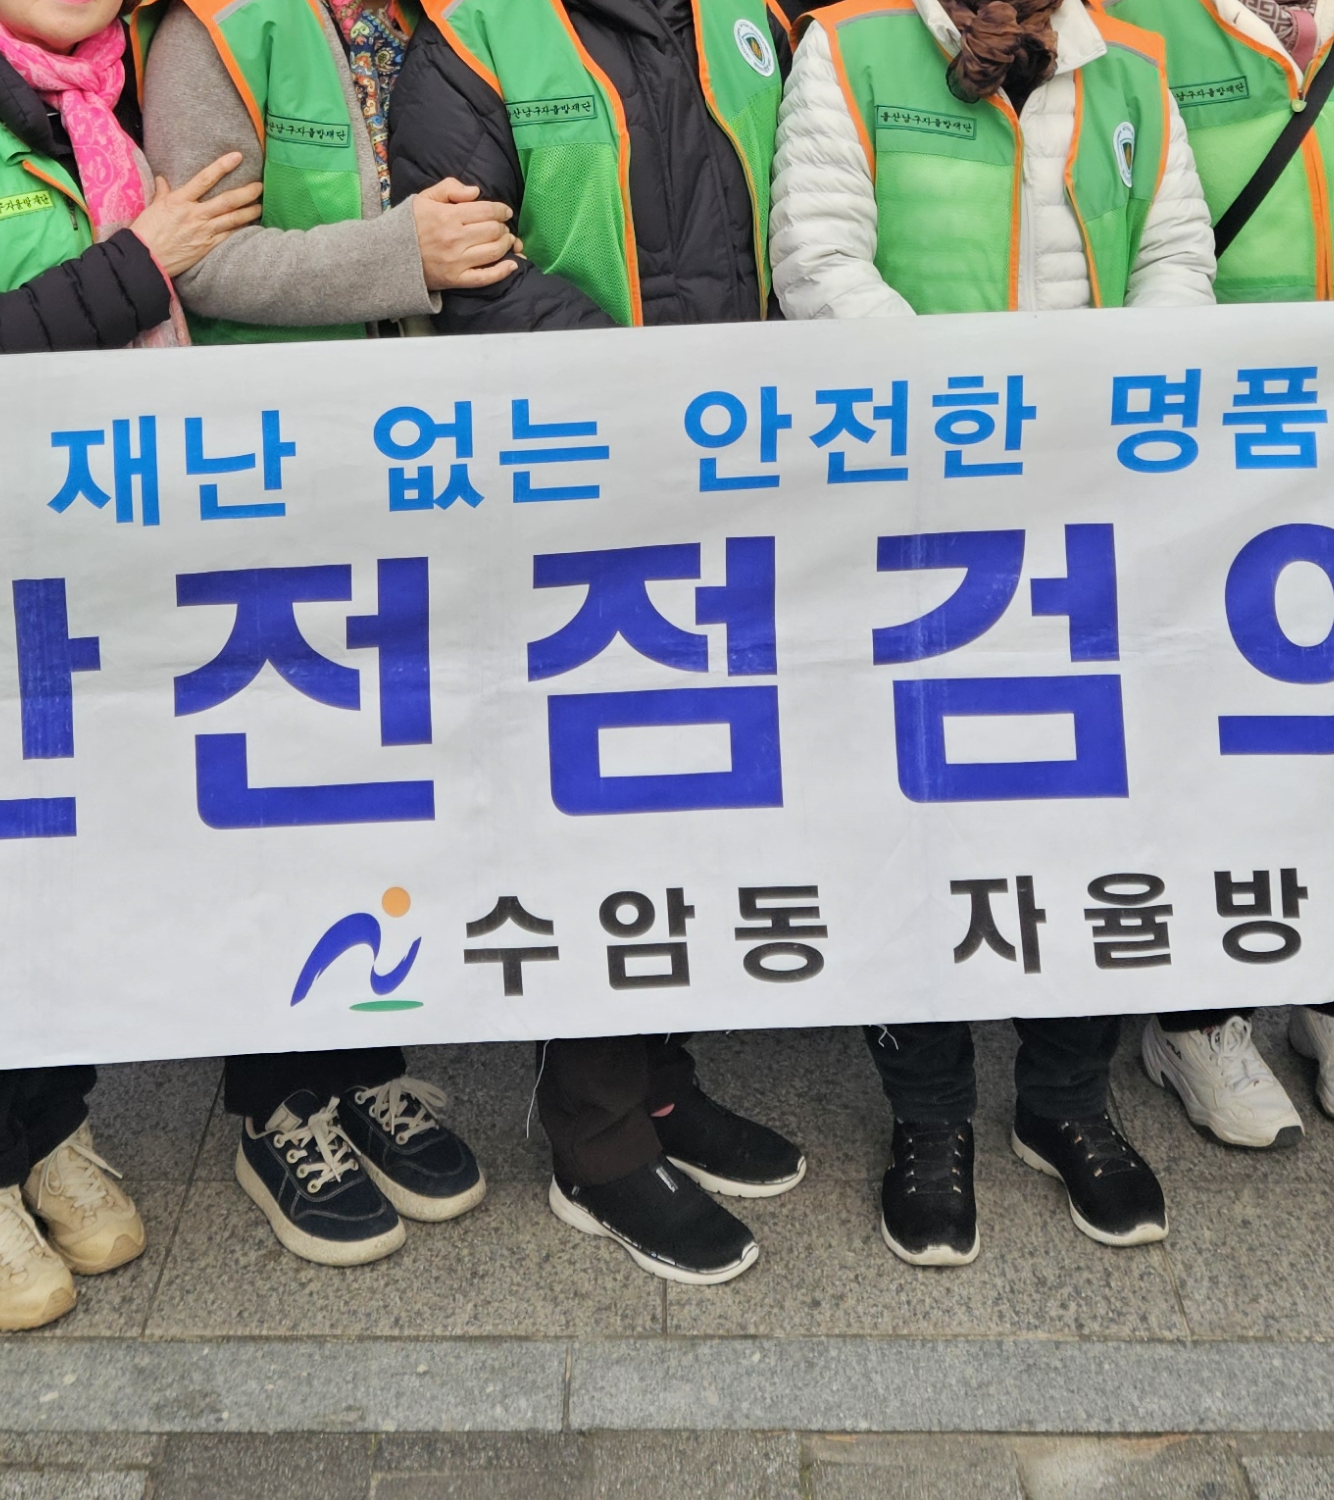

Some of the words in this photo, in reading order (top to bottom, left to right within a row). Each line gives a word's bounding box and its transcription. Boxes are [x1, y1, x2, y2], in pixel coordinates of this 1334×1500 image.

[47, 410, 297, 527] 재난
[372, 398, 610, 511] 없는
[684, 375, 1037, 491] 안전한
[1110, 366, 1328, 474] 명품
[464, 885, 828, 996] 수암동
